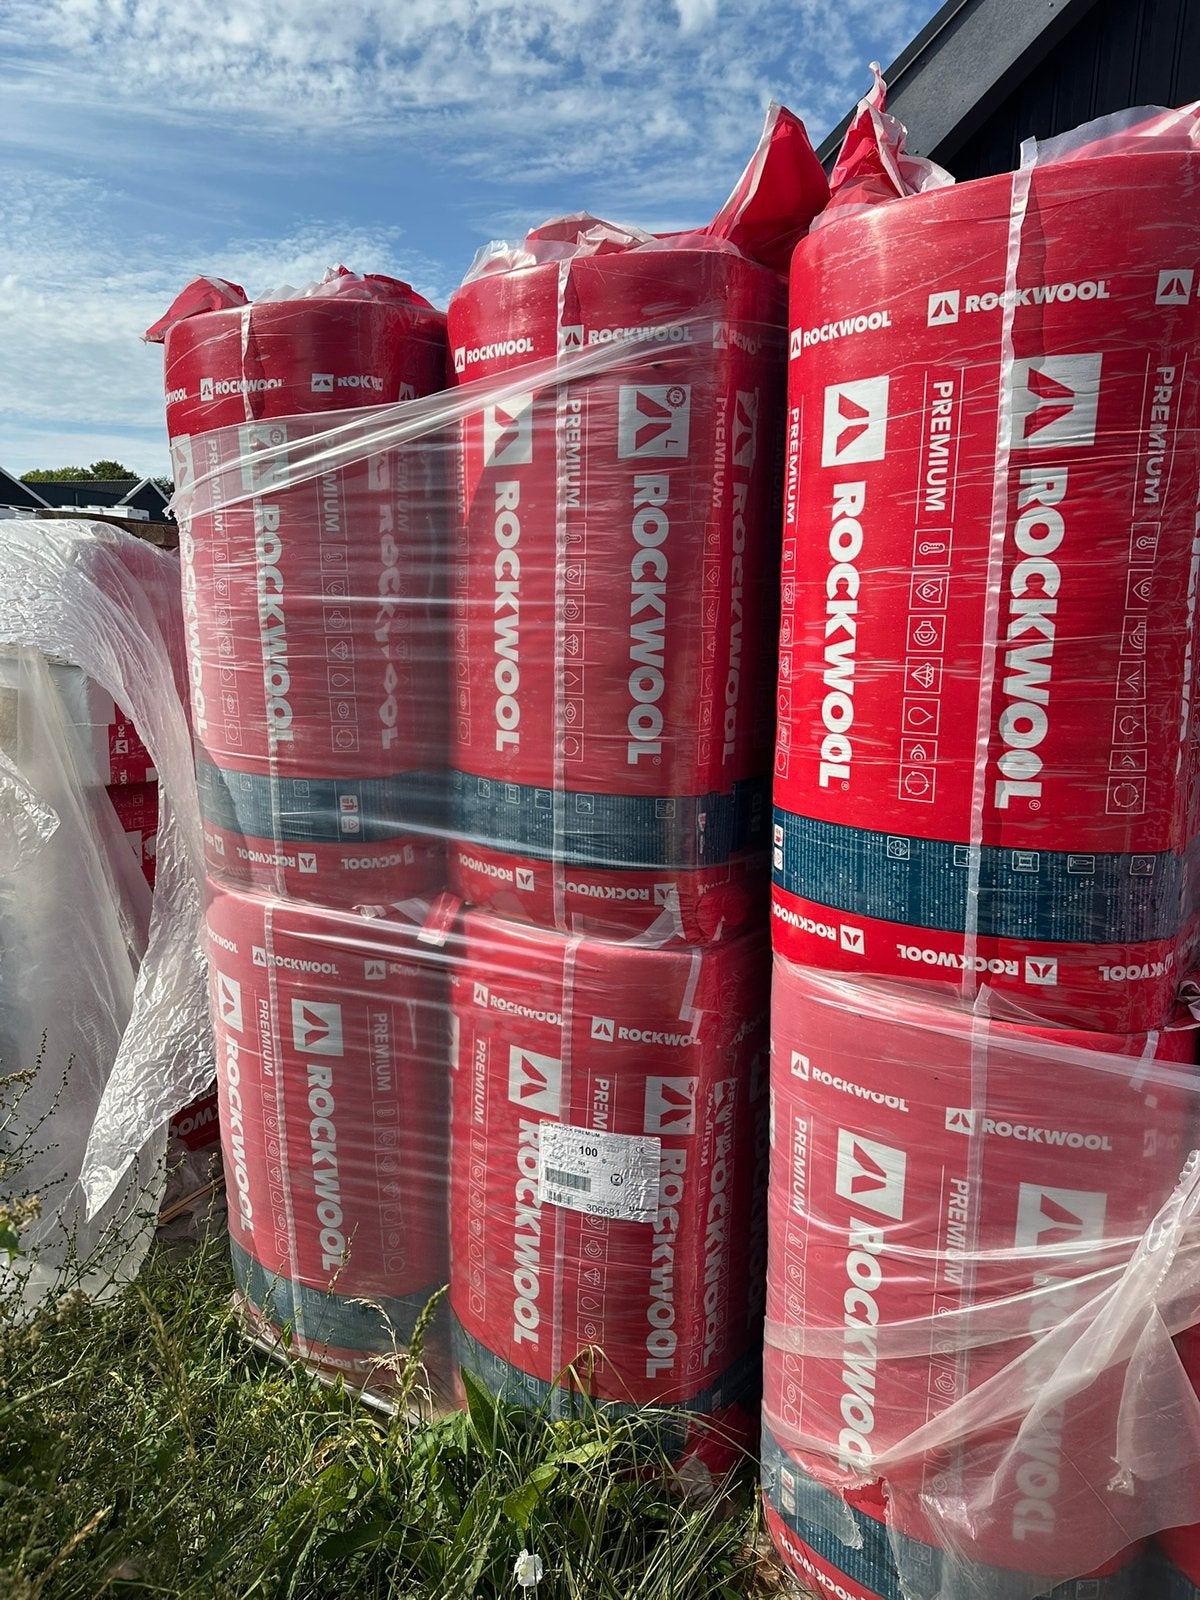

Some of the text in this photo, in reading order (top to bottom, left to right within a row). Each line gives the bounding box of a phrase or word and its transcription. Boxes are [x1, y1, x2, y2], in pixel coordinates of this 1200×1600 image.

[588, 325, 693, 345] ROCKWOOL
[803, 311, 891, 345] ROCKWOOL
[965, 281, 1109, 313] ROCKWOOL
[466, 337, 534, 363] ROCKWOOL
[562, 399, 582, 508] PREMIUM
[711, 397, 728, 508] PREMIUM
[786, 408, 799, 524] PREMIUM
[925, 381, 953, 511] PREMIUM
[1143, 366, 1175, 503] PREMIUM
[257, 504, 294, 750] ROCKWOOL
[494, 480, 521, 752] ROCKWOOL
[627, 475, 670, 765] ROCKWOOL
[818, 481, 866, 788] ROCKWOOL
[994, 466, 1069, 809] ROCKWOOL
[237, 847, 296, 868] ROCKWOOL
[459, 853, 513, 881] ROCKWOOL
[560, 880, 649, 901] ROCKWOOL
[897, 944, 1019, 976] ROCKWOOL
[258, 998, 274, 1077] PREMIUM
[374, 1012, 393, 1092] PREMIUM
[490, 995, 564, 1026] ROCKWOOL
[474, 1039, 487, 1125] PREMIUM
[812, 1066, 909, 1112] ROCKWOOL
[224, 1032, 255, 1235] ROCKWOOL
[306, 1063, 346, 1272] ROCKWOOL
[579, 1145, 598, 1157] 100
[793, 1117, 808, 1211] PREMIUM
[982, 1117, 1112, 1151] ROCKWOOL
[585, 1203, 620, 1217] 306681
[942, 1177, 971, 1285] PREMIUM
[645, 1148, 688, 1379] ROCKWOOL
